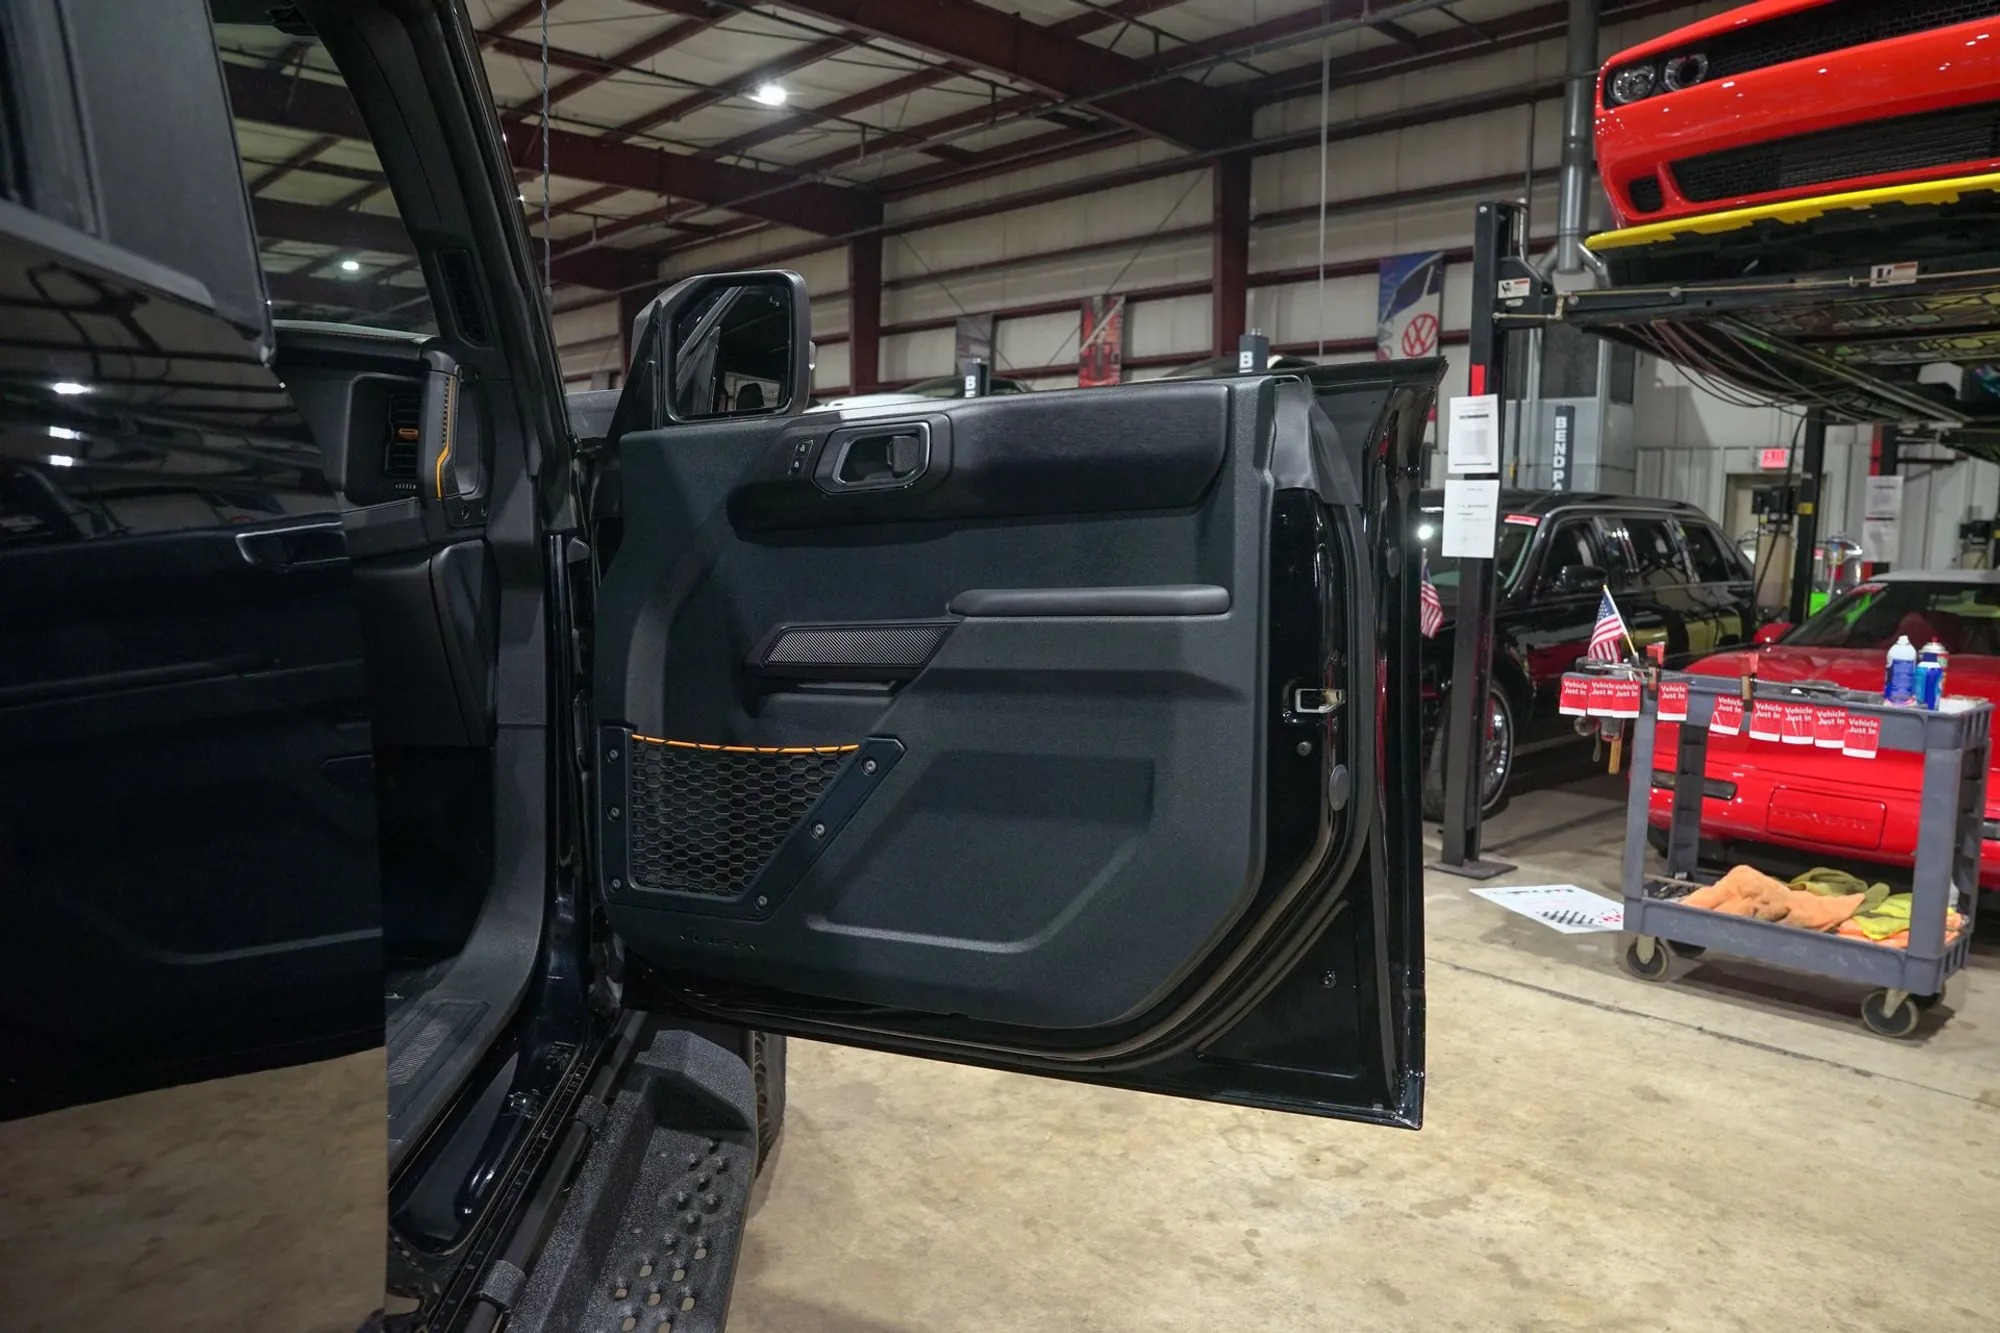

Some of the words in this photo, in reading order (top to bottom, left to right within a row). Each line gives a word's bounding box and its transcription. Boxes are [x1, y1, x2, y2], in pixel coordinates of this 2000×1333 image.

[1552, 416, 1568, 491] BENDPA
[1564, 681, 1587, 689] Vehicle
[1615, 683, 1639, 691] Vehicle
[1661, 685, 1686, 693] Vehicle
[1662, 692, 1676, 700] Just
[1717, 704, 1735, 713] Just
[1736, 706, 1742, 714] In
[1755, 702, 1782, 712] Vehicle
[1785, 706, 1813, 715] Vehicle
[1755, 710, 1772, 719] Just
[1785, 714, 1802, 722] Just
[1805, 714, 1812, 722] In
[1817, 710, 1846, 719] Vehicle
[1849, 719, 1878, 728] Vehicle
[1849, 726, 1866, 735] Just
[1868, 727, 1876, 735] In
